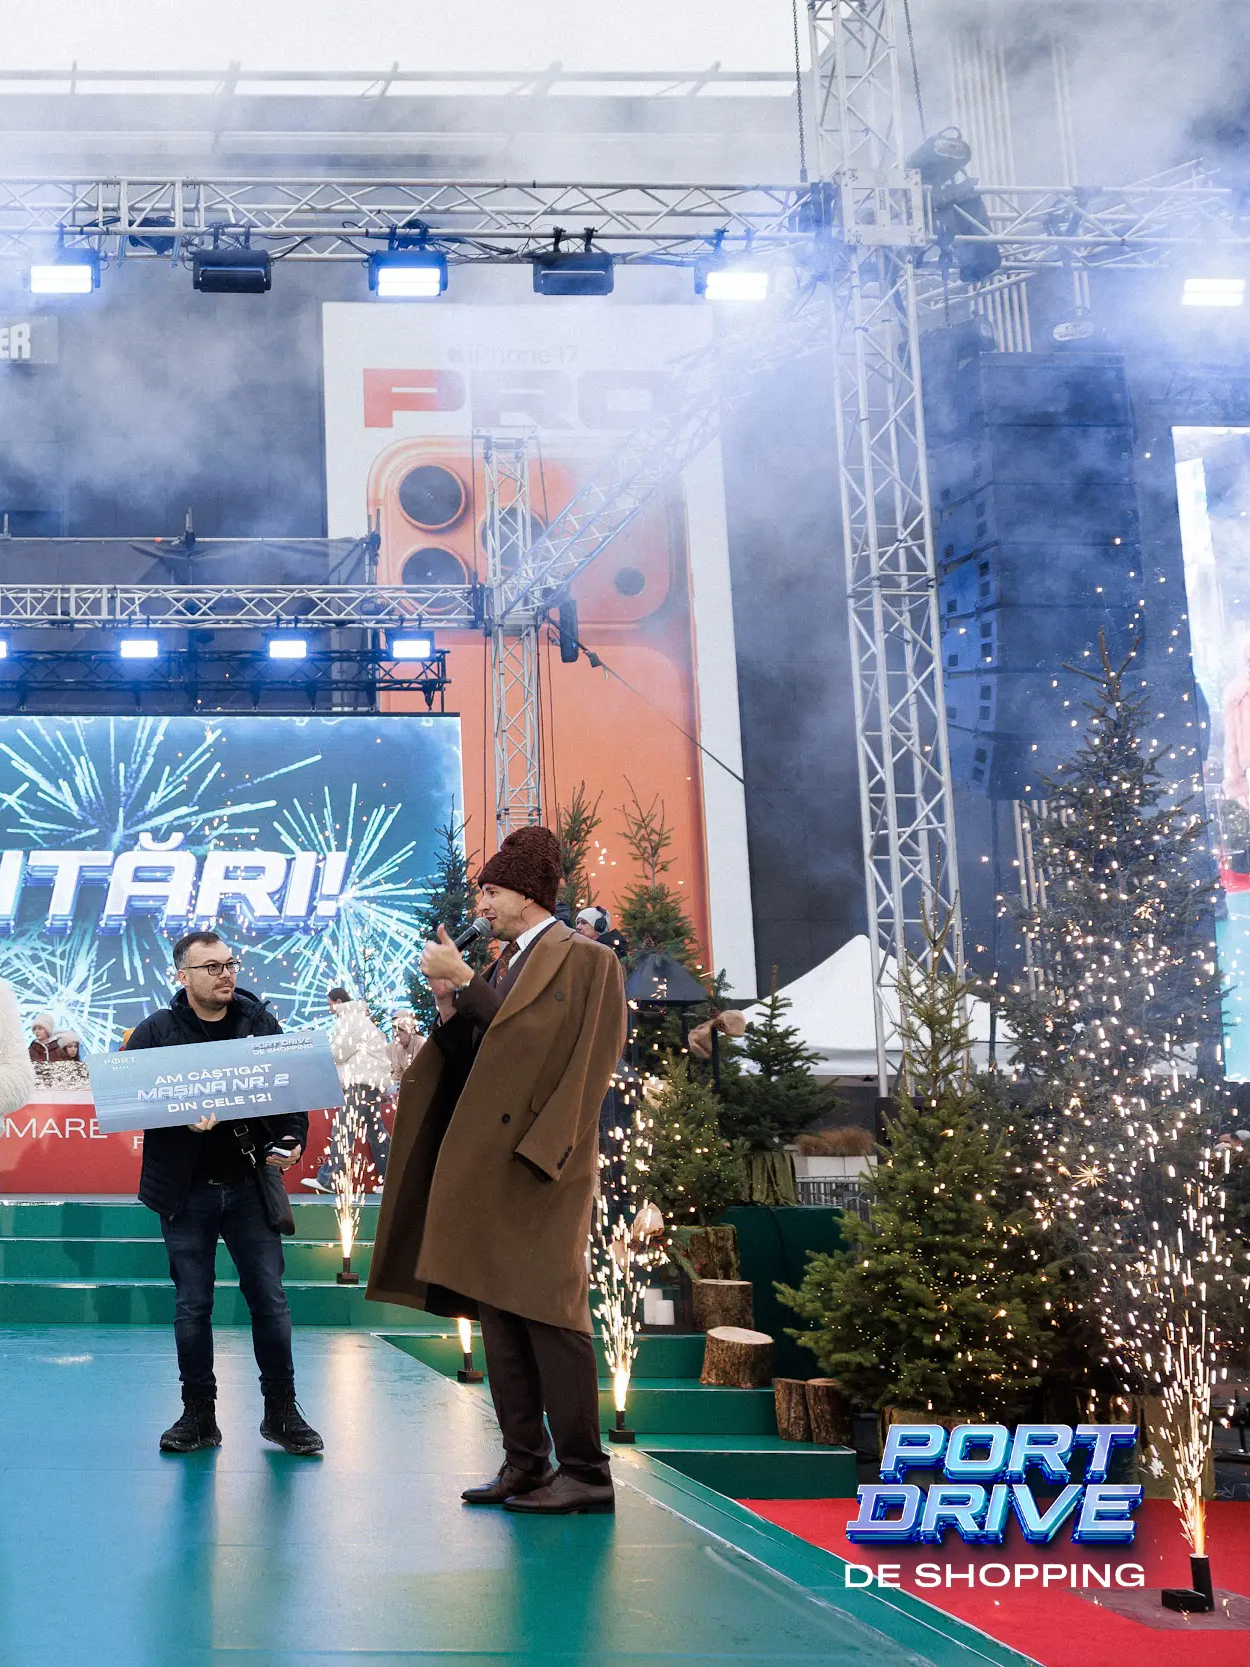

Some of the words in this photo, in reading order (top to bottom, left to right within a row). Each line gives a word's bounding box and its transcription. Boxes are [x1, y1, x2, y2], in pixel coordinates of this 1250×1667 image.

[363, 368, 684, 430] PRO
[267, 1043, 314, 1054] SHOPPING
[104, 1056, 136, 1066] PORT
[155, 1073, 183, 1085] AM
[187, 1063, 272, 1081] CÂȘTIGAT
[137, 1080, 226, 1102] MAȘINA
[232, 1075, 270, 1091] NR.
[273, 1073, 290, 1087] 2
[167, 1101, 198, 1113] DIN
[202, 1096, 245, 1110] CELE
[248, 1092, 273, 1104] 12!
[5, 1118, 107, 1138] MARE
